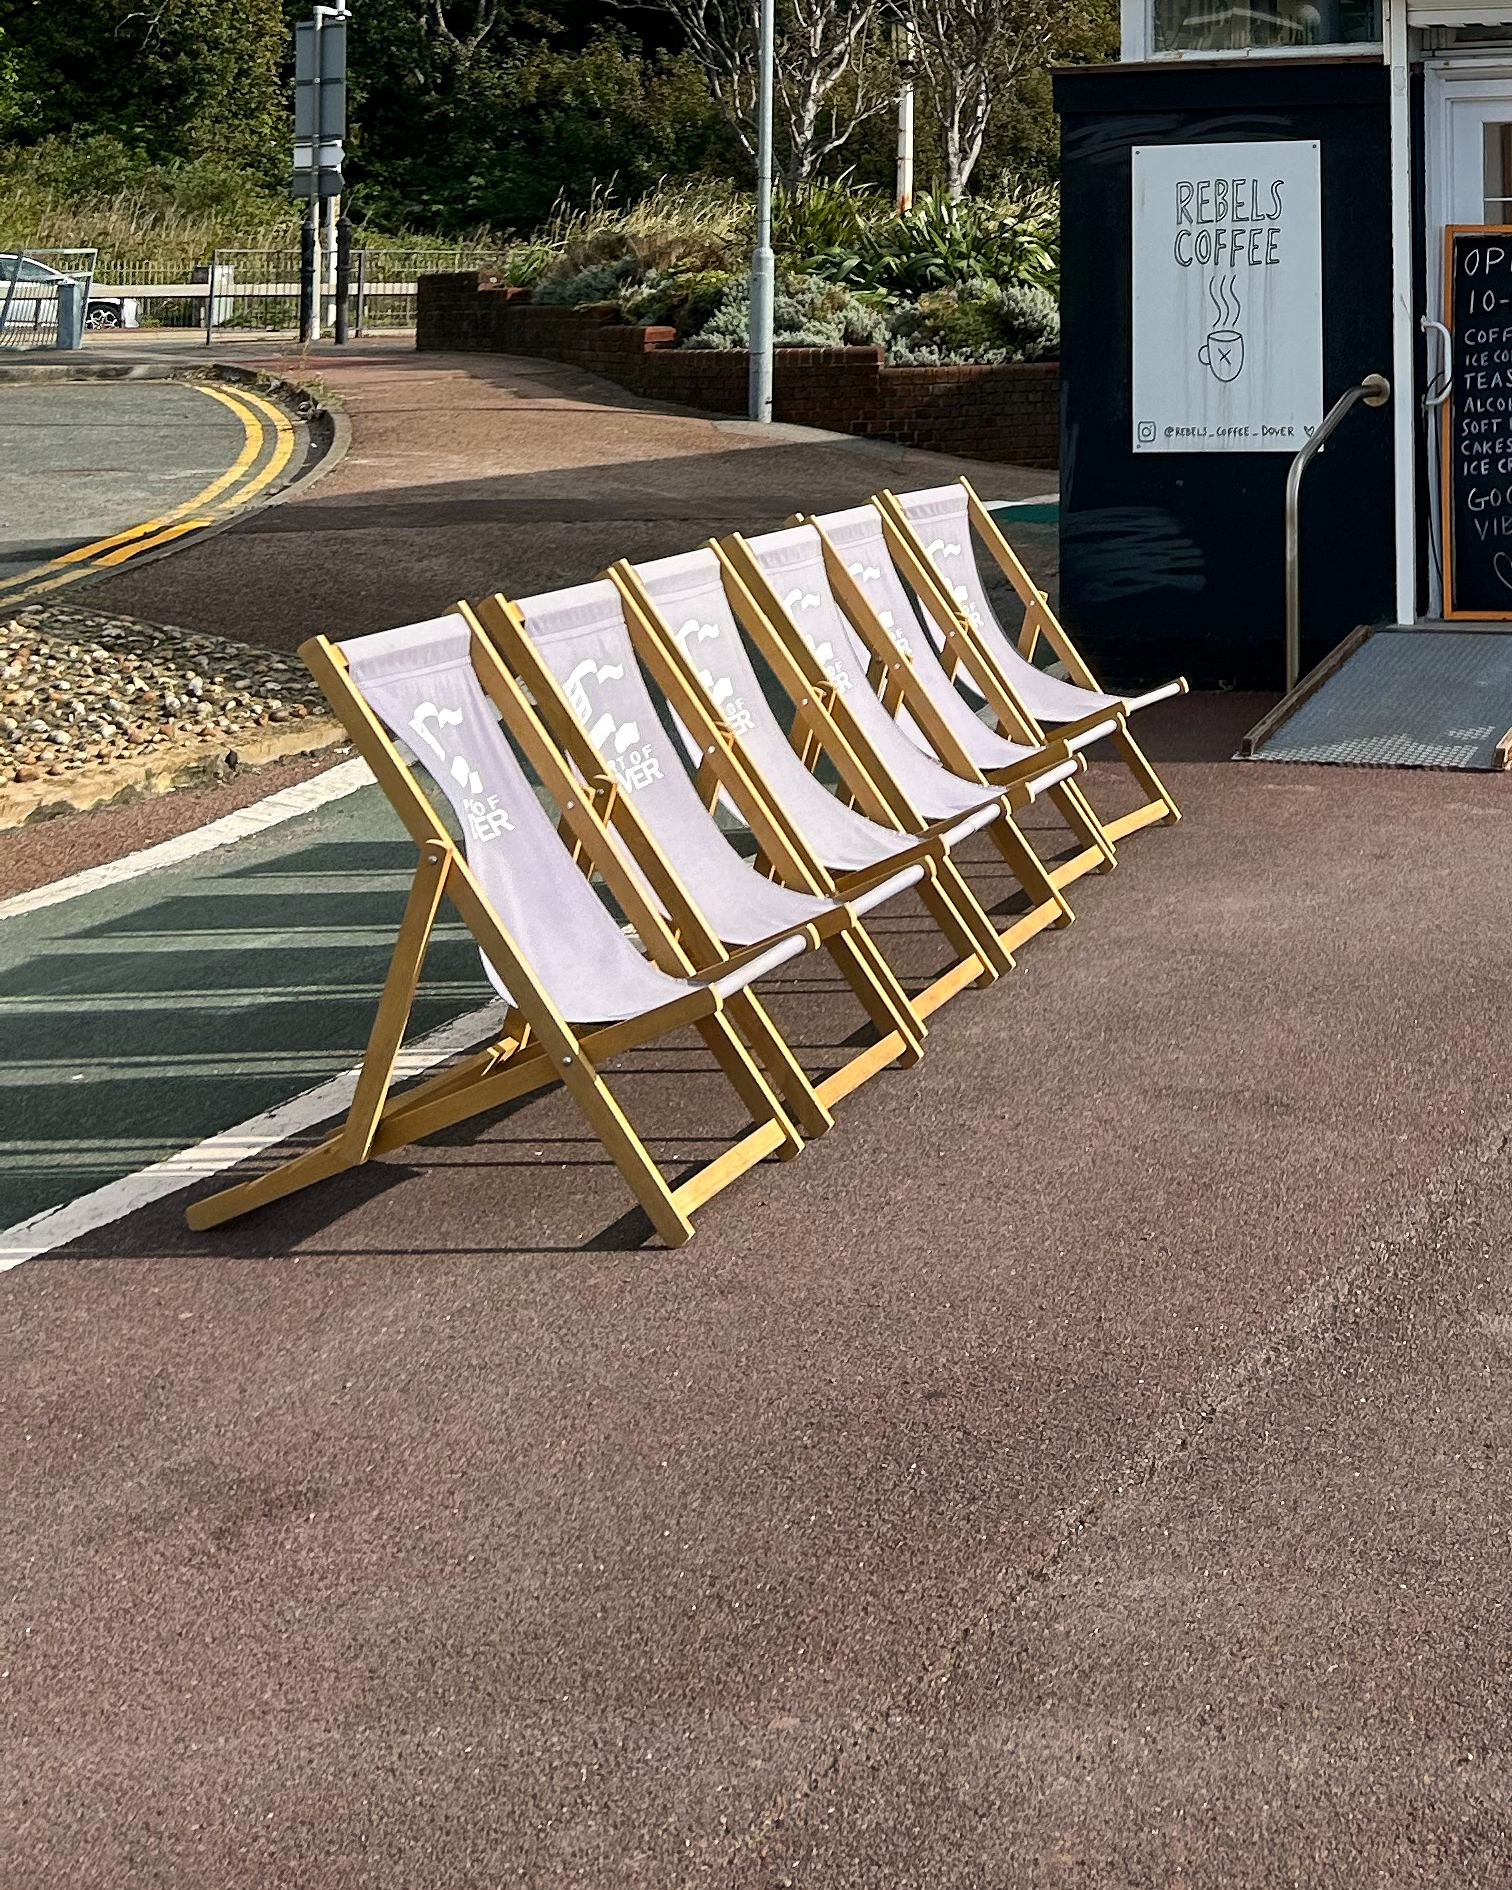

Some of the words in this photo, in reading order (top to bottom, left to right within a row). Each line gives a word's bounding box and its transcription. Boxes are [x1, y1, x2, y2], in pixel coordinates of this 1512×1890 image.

[1175, 178, 1285, 225] REBELS
[1174, 227, 1281, 267] COFFEE
[1465, 351, 1489, 366] ICE
[1461, 418, 1502, 437] SOFT
[1463, 459, 1490, 476] ICE
[629, 744, 653, 765] OF
[615, 758, 665, 794] VER
